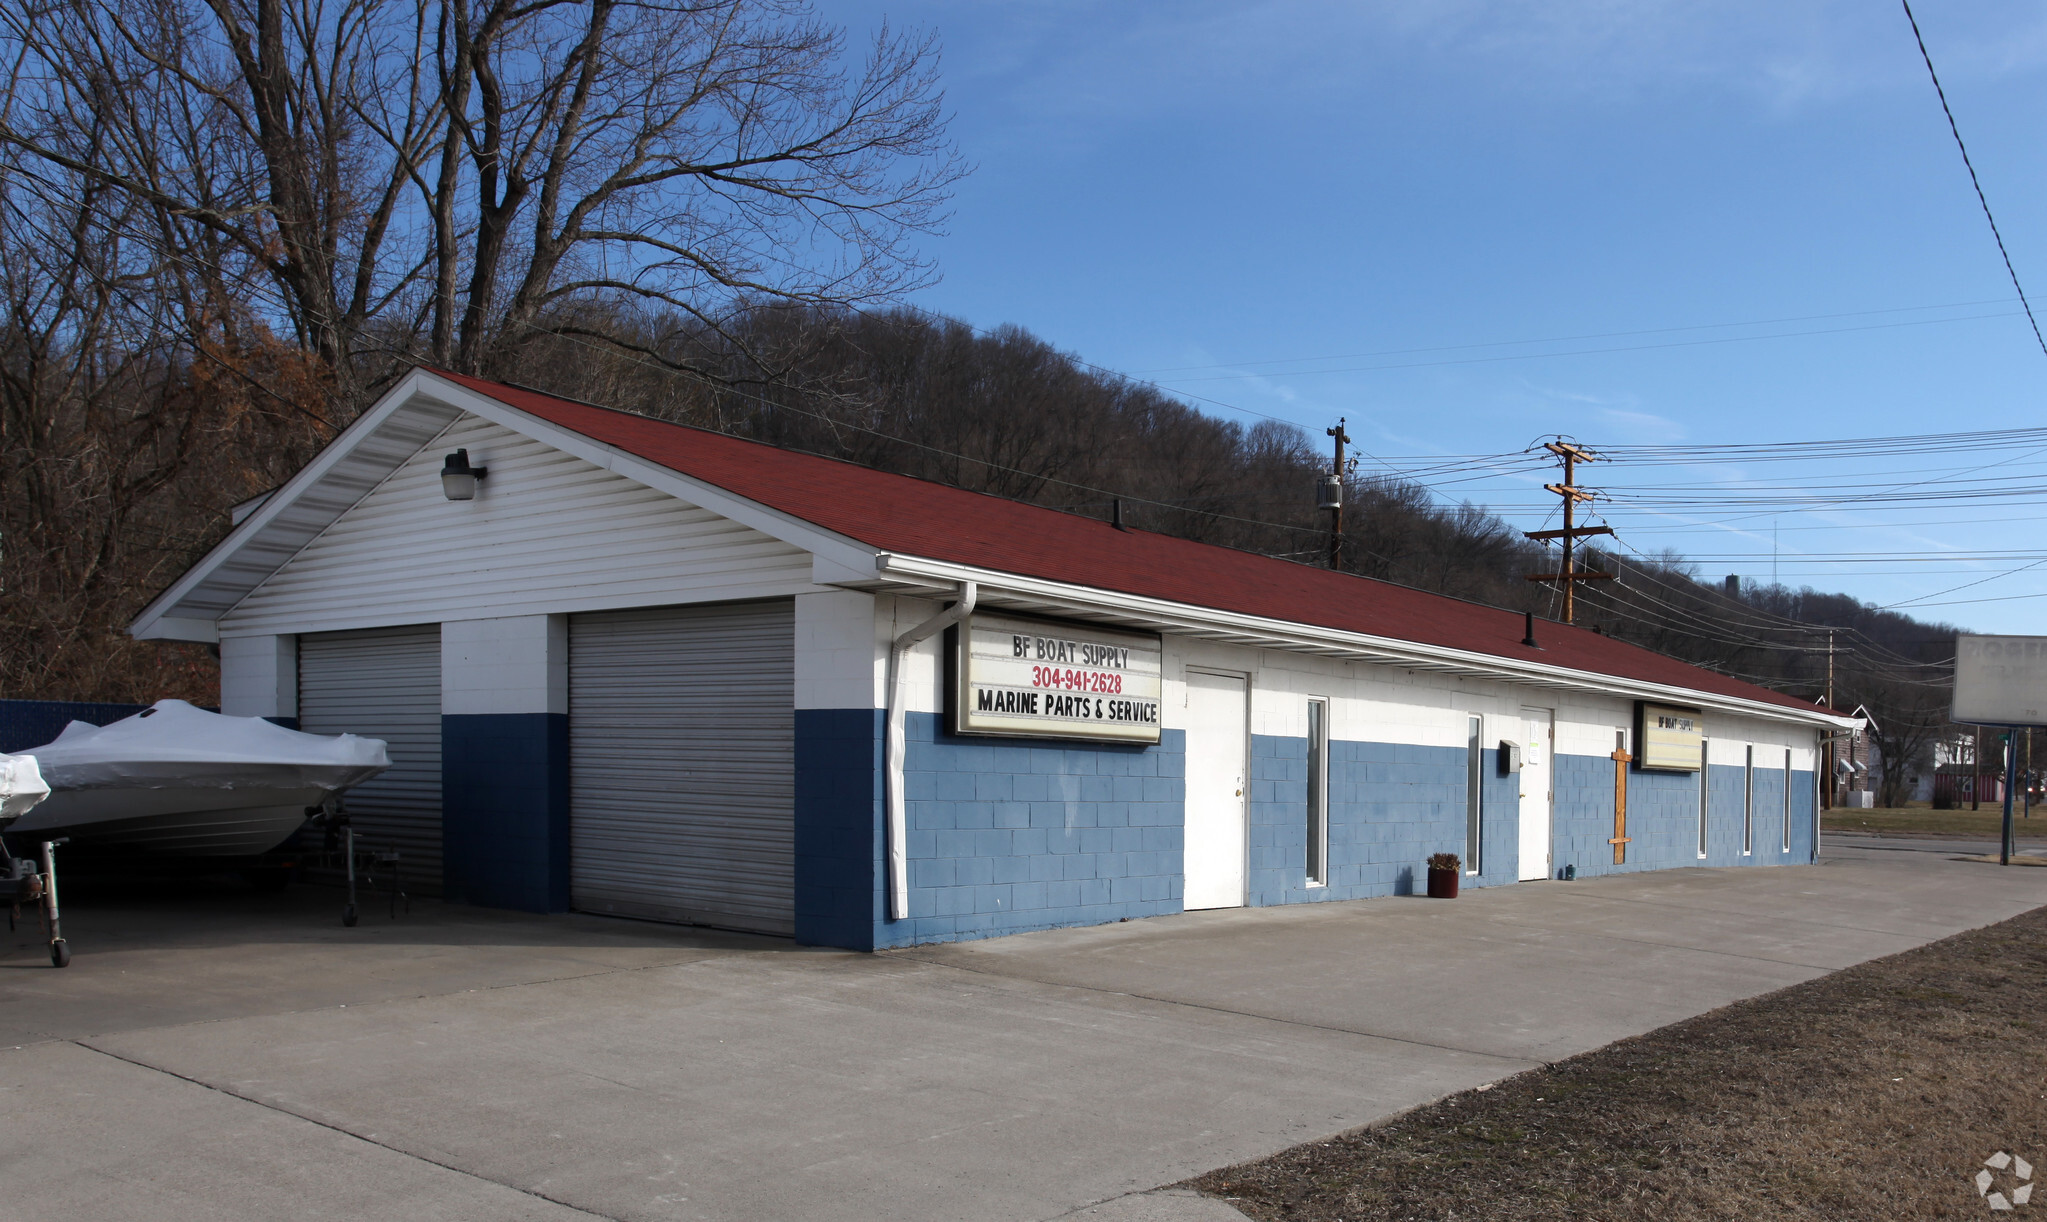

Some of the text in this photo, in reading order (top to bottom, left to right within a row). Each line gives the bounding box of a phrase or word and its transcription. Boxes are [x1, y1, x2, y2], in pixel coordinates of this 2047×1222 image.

[1013, 634, 1129, 669] BF BOAT SUPPLY
[1032, 665, 1122, 694] 304-941-2628
[978, 688, 1157, 723] MARINE PARTS & SERVICE
[1665, 717, 1677, 730] BOAT
